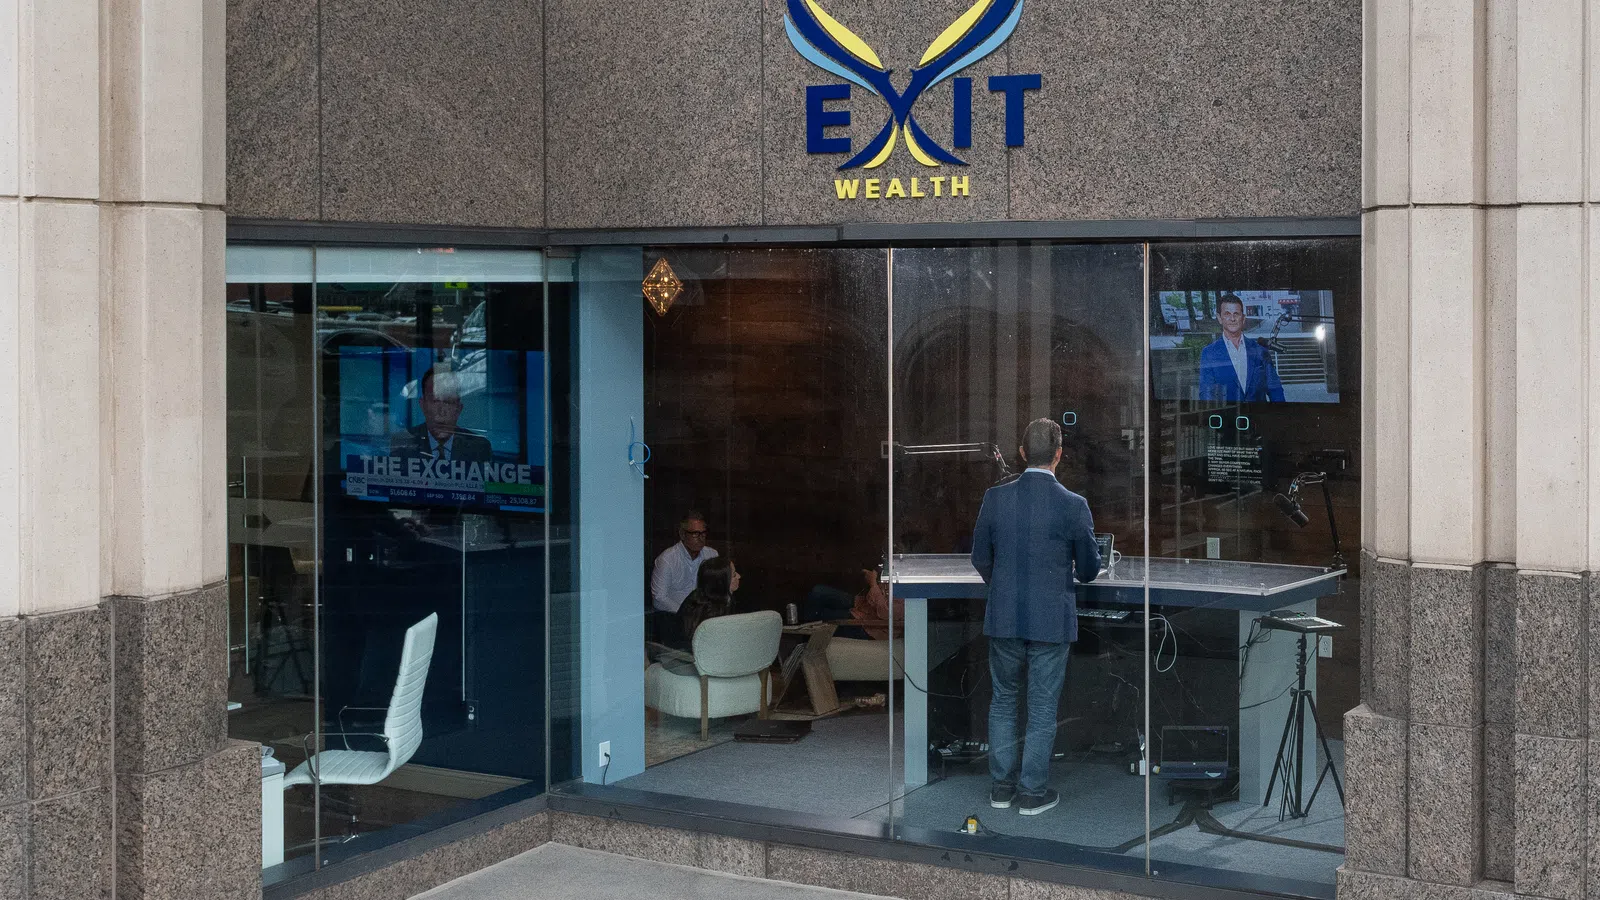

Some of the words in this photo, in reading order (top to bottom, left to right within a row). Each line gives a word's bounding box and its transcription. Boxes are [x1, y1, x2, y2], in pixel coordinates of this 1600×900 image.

[806, 70, 1042, 171] EXIT
[834, 176, 970, 200] WEALTH
[348, 476, 366, 484] CNBC
[360, 455, 401, 476] THE
[408, 459, 531, 485] EXCHANGE
